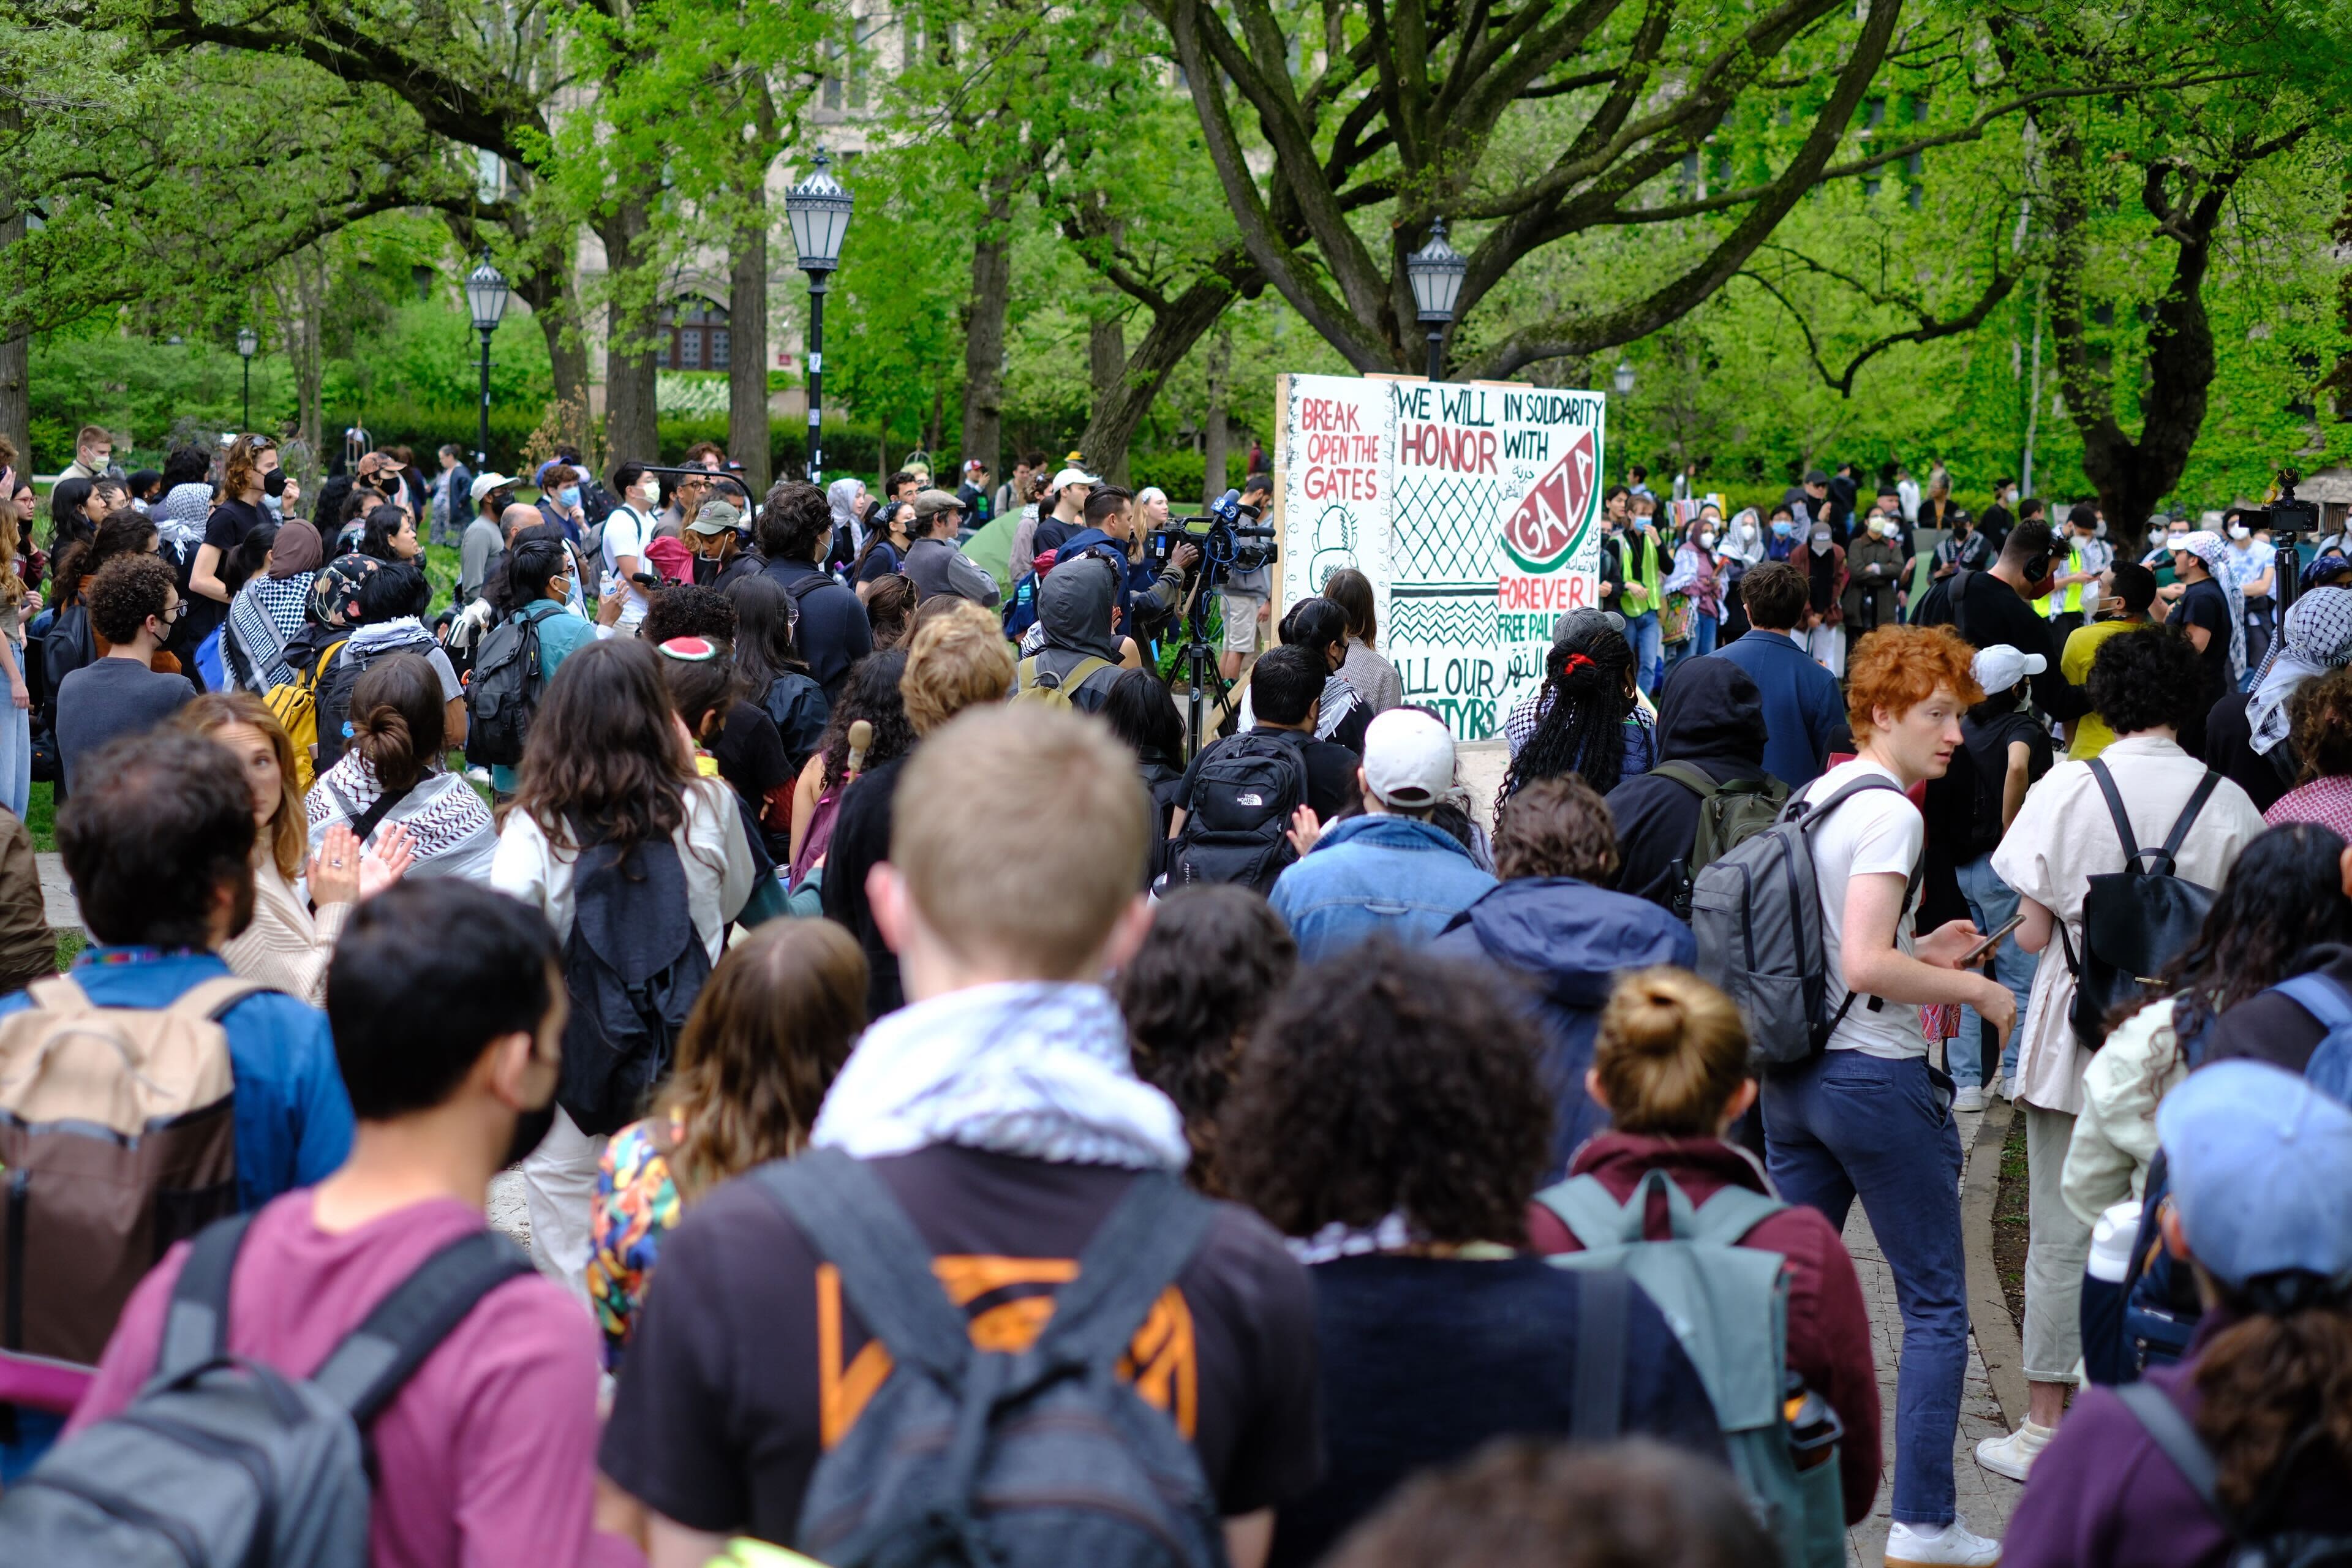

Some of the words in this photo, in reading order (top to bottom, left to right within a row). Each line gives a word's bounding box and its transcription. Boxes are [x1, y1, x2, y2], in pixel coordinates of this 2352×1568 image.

[1302, 398, 1360, 433] BREAK
[1396, 385, 1431, 420] WE
[1440, 388, 1494, 427] WILL
[1504, 393, 1522, 422] IN
[1526, 394, 1603, 427] SOLIDARITY
[1308, 433, 1349, 465] OPEN
[1351, 435, 1379, 464] THE
[1401, 423, 1498, 475] HONOR
[1504, 429, 1548, 461] WITH
[1305, 466, 1377, 500] GATES
[1515, 448, 1592, 555] GAZA
[1498, 614, 1526, 644] FREE
[1446, 658, 1498, 698] OUR
[1402, 698, 1497, 740] TYRS
